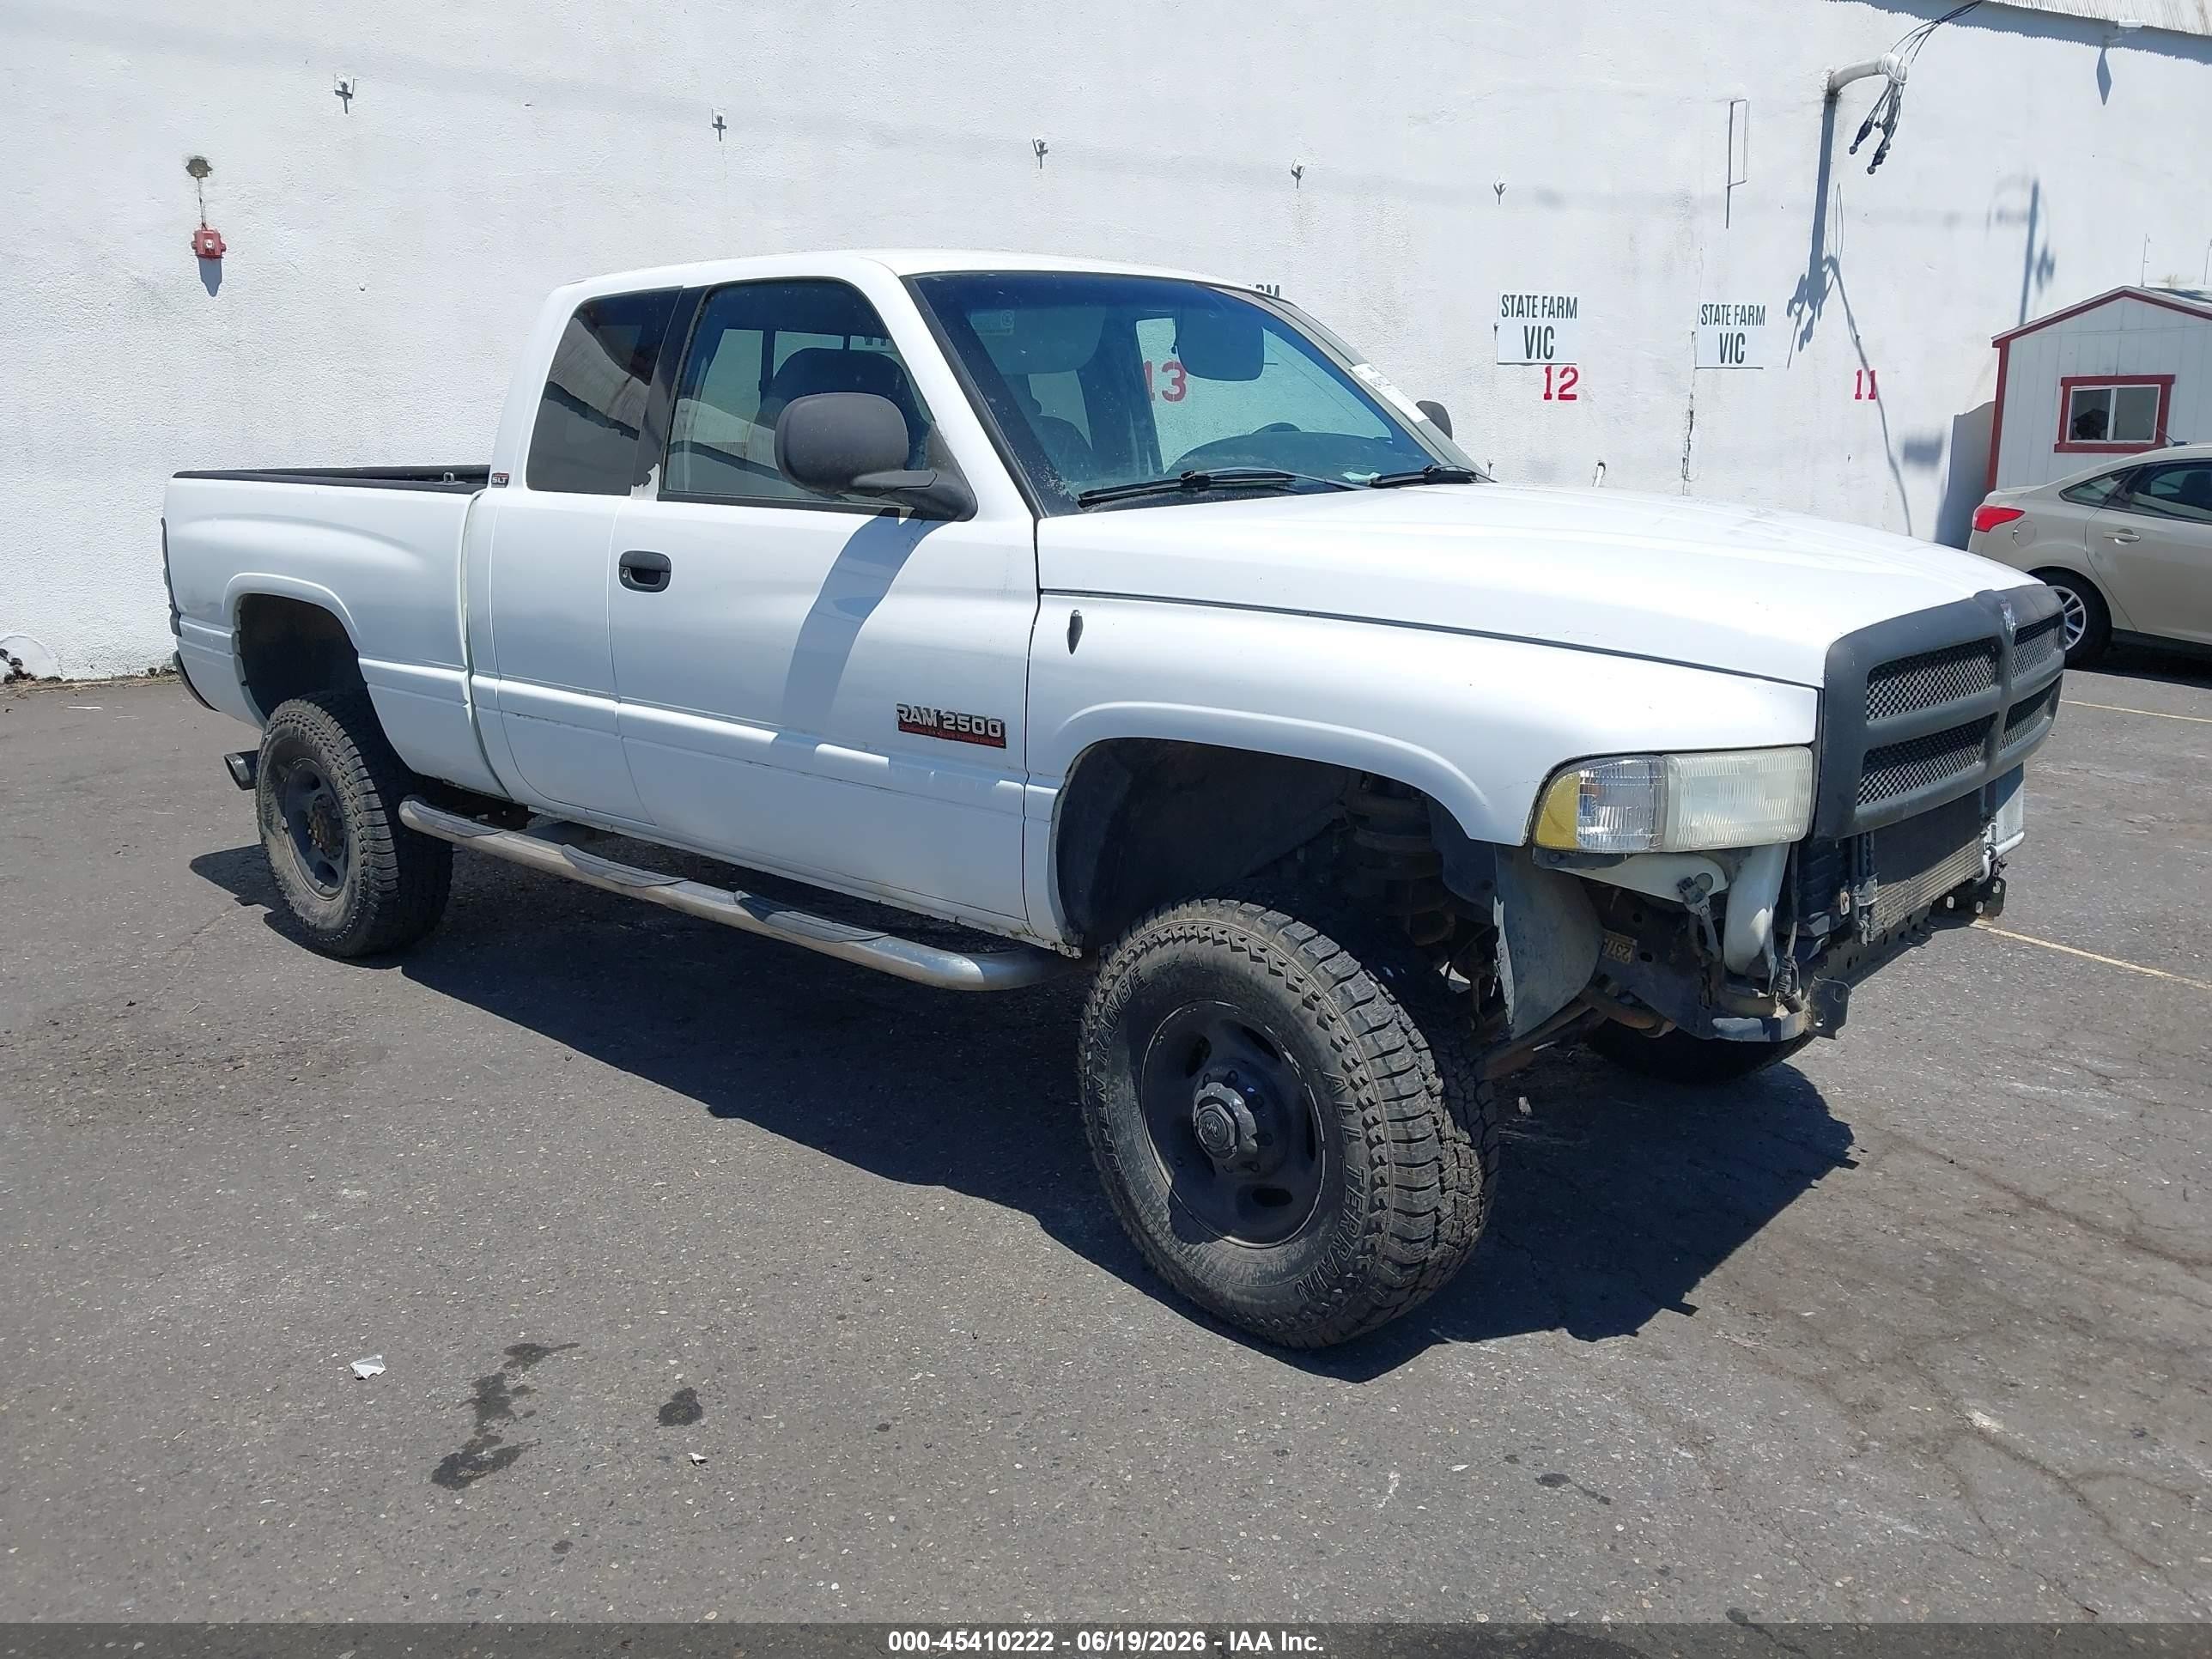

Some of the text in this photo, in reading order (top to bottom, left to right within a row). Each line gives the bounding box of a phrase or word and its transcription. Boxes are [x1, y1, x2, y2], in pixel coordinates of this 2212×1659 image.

[1501, 294, 1578, 319] STATE FARM
[1700, 303, 1766, 326] STATE FARM
[1523, 325, 1555, 360] VIC
[1719, 331, 1746, 364] VIC
[1144, 360, 1187, 402] 13
[1543, 365, 1579, 401] 12
[1854, 369, 1876, 400] 11
[896, 704, 938, 728] RAM
[942, 712, 1003, 738] 2500
[1297, 1071, 1366, 1302] ALL TERRAIN
